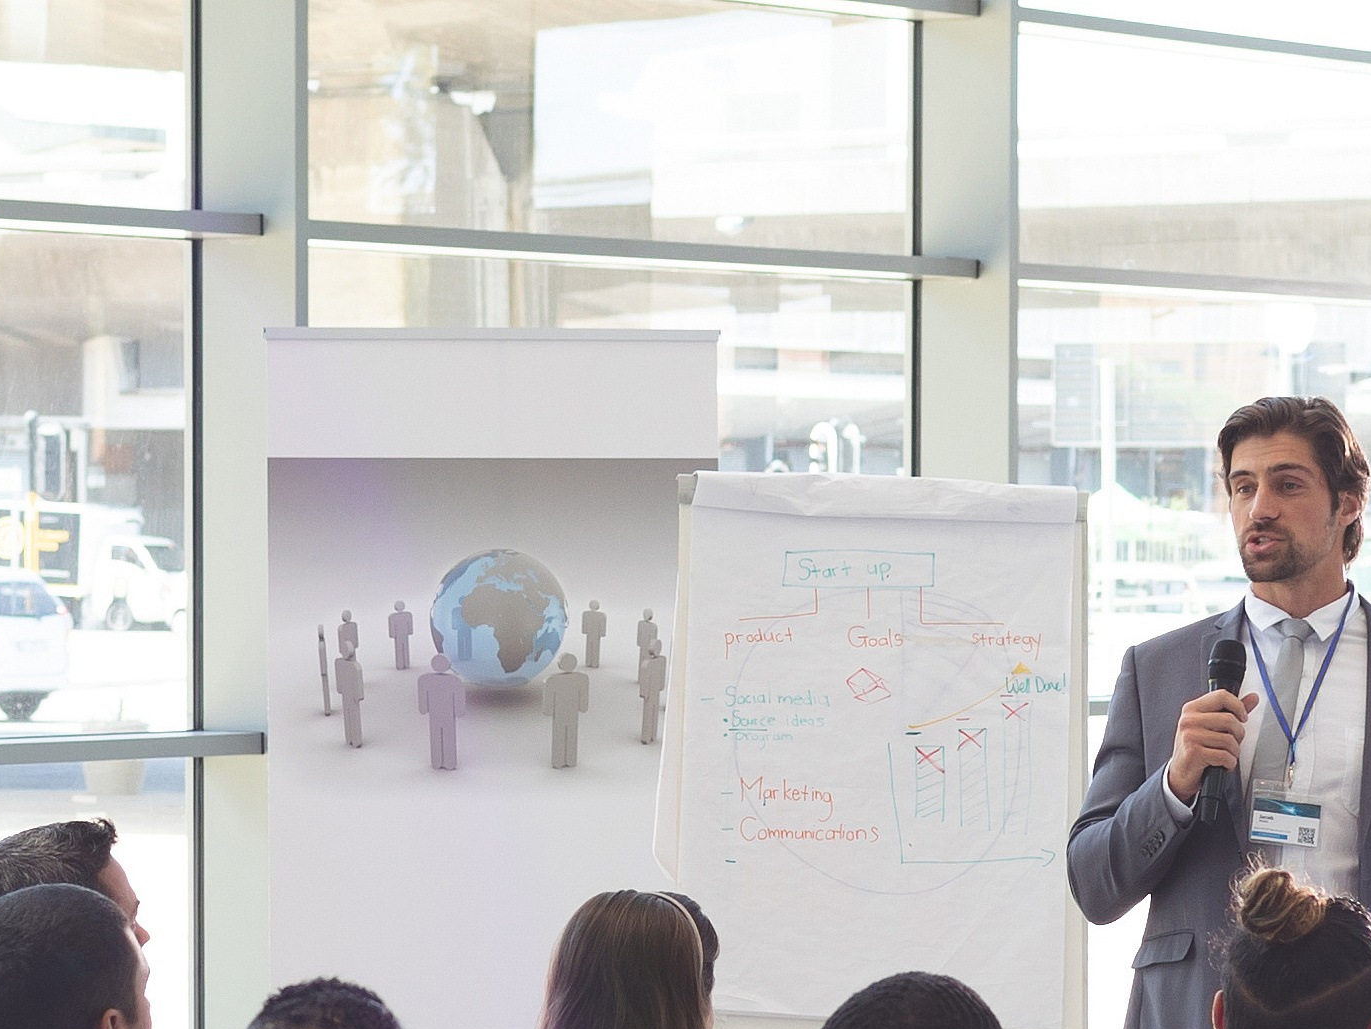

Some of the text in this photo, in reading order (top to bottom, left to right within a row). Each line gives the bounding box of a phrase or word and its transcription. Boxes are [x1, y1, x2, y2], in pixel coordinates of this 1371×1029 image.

[798, 558, 852, 581] Start
[724, 627, 793, 660] product
[847, 625, 904, 649] Goals
[724, 685, 772, 707] Social
[1005, 676, 1031, 694] Well
[740, 776, 834, 822] Marketing
[739, 816, 879, 843] Communications
